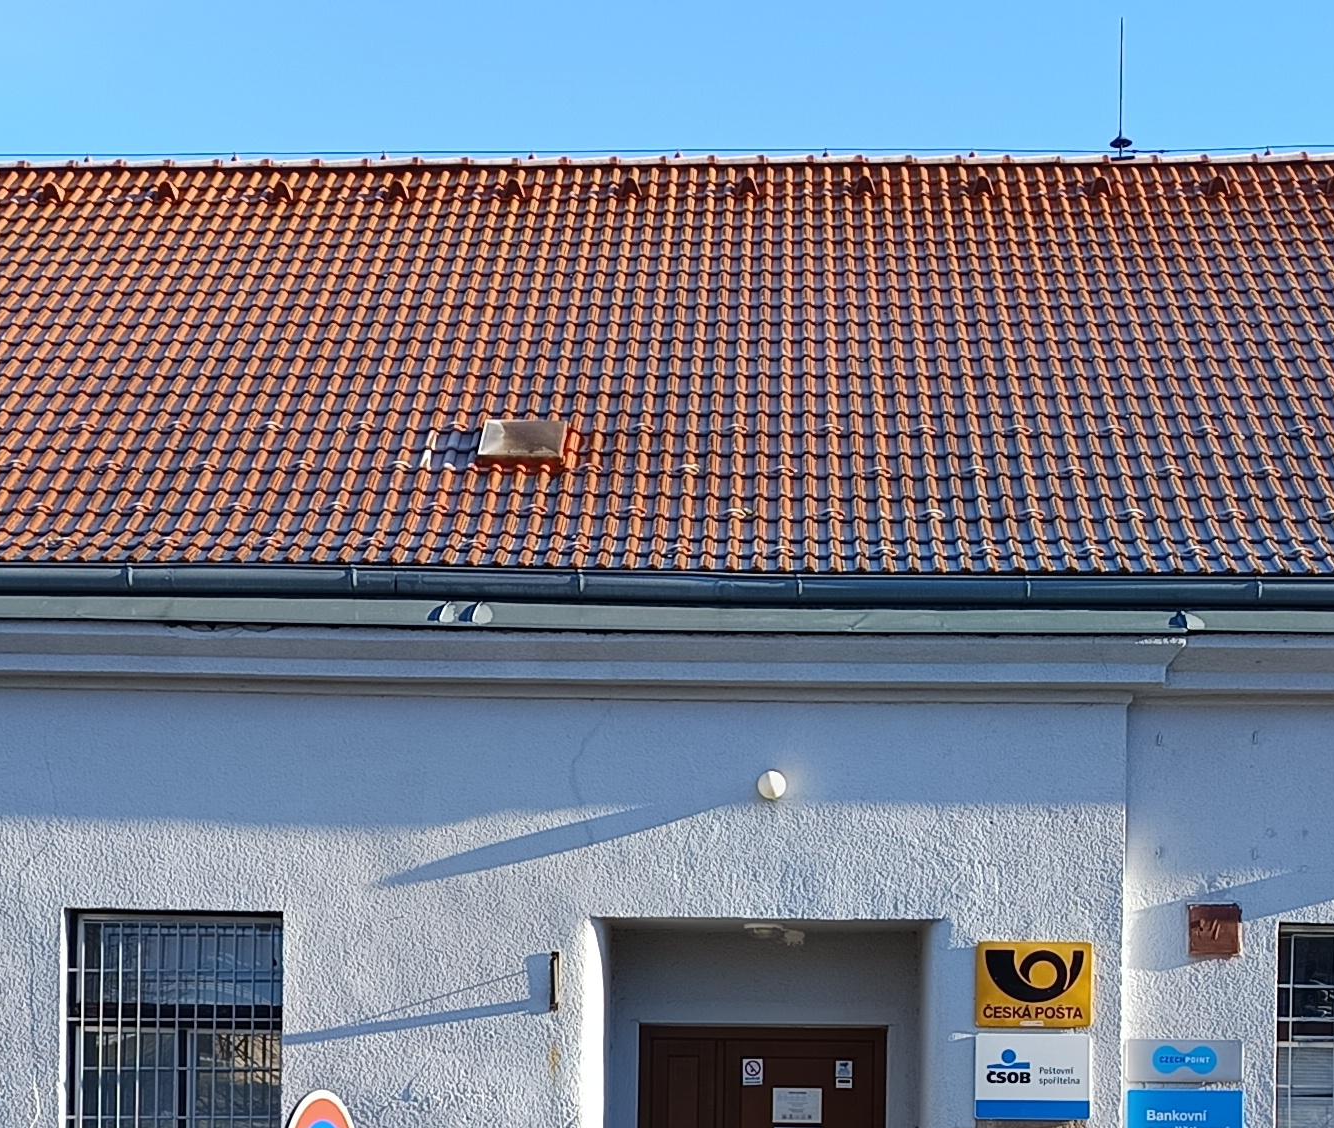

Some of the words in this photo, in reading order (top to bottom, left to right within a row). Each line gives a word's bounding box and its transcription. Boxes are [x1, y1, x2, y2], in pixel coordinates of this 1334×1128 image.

[983, 1004, 1032, 1019] ČESKÁ
[1035, 1004, 1083, 1019] POŠTA
[1039, 1066, 1074, 1075] Poštovní
[986, 1070, 1031, 1084] ČSOB
[1039, 1077, 1080, 1086] spořitelna
[1146, 1109, 1207, 1121] Bankovní
